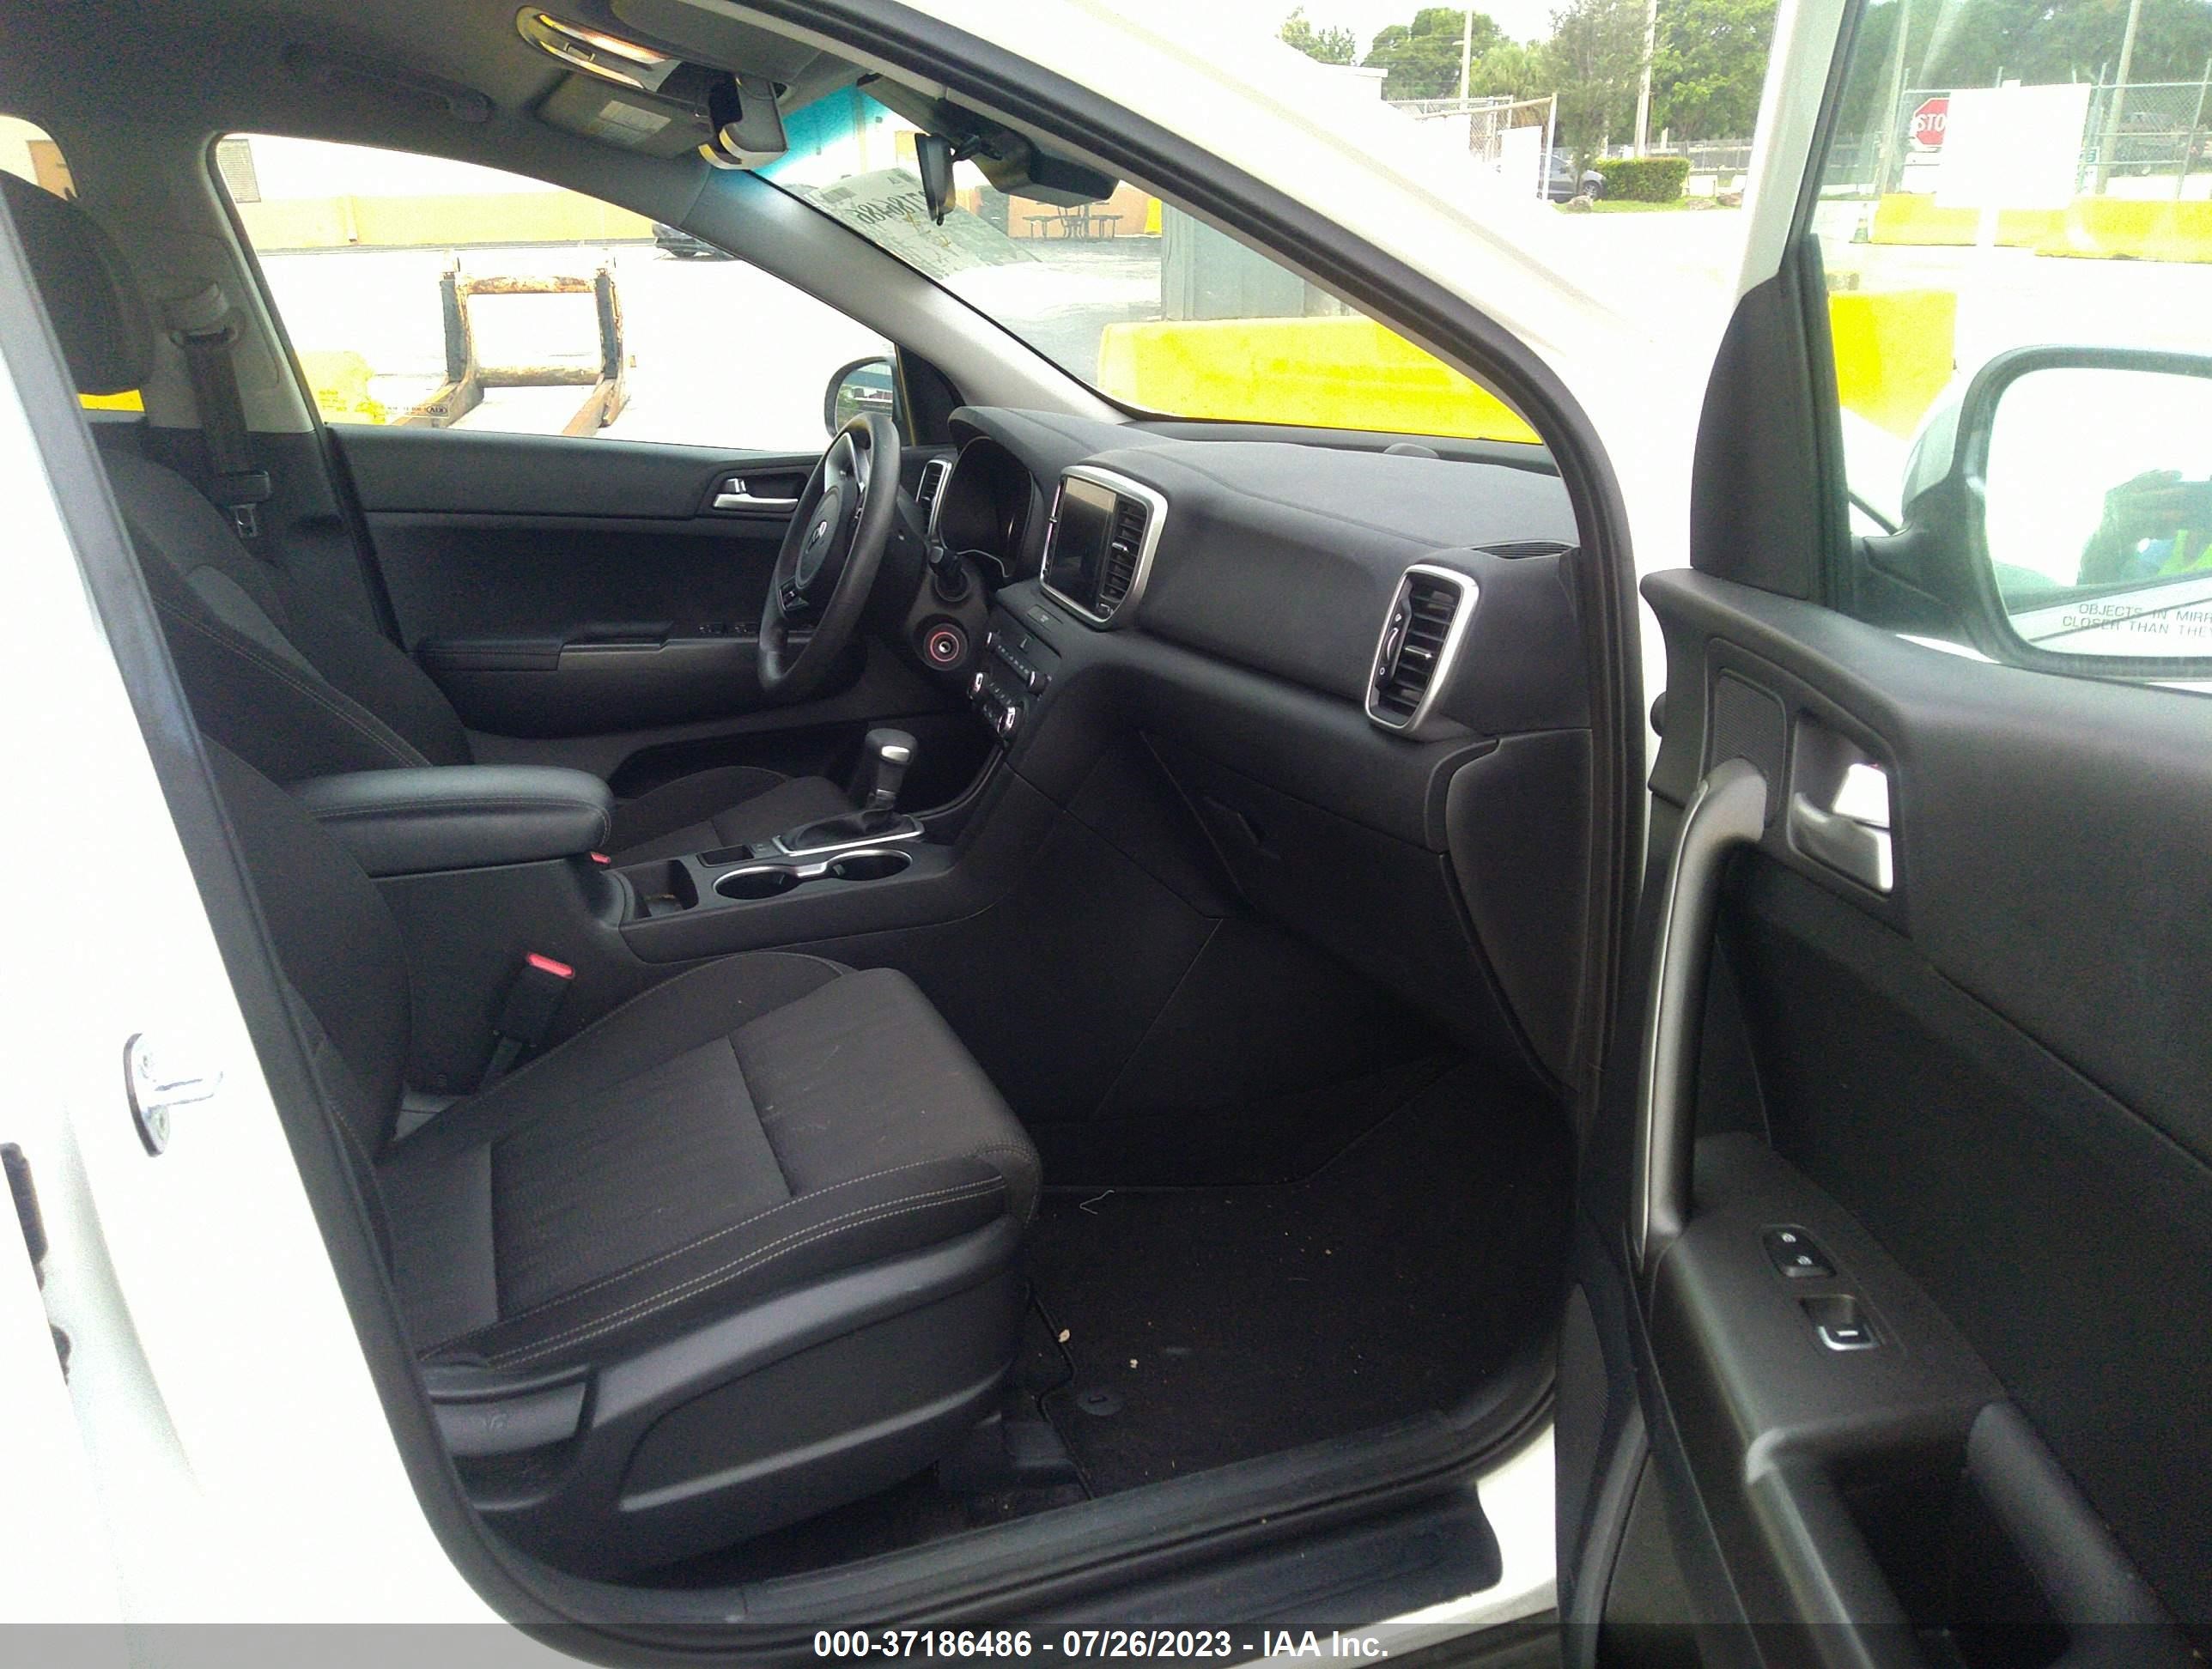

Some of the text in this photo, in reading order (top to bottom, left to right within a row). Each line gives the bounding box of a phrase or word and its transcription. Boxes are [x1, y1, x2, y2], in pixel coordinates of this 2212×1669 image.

[2078, 603, 2143, 617] OBJECTS
[2151, 610, 2167, 620] IN
[2063, 616, 2120, 632] CLOSER
[2130, 621, 2170, 634] THAN
